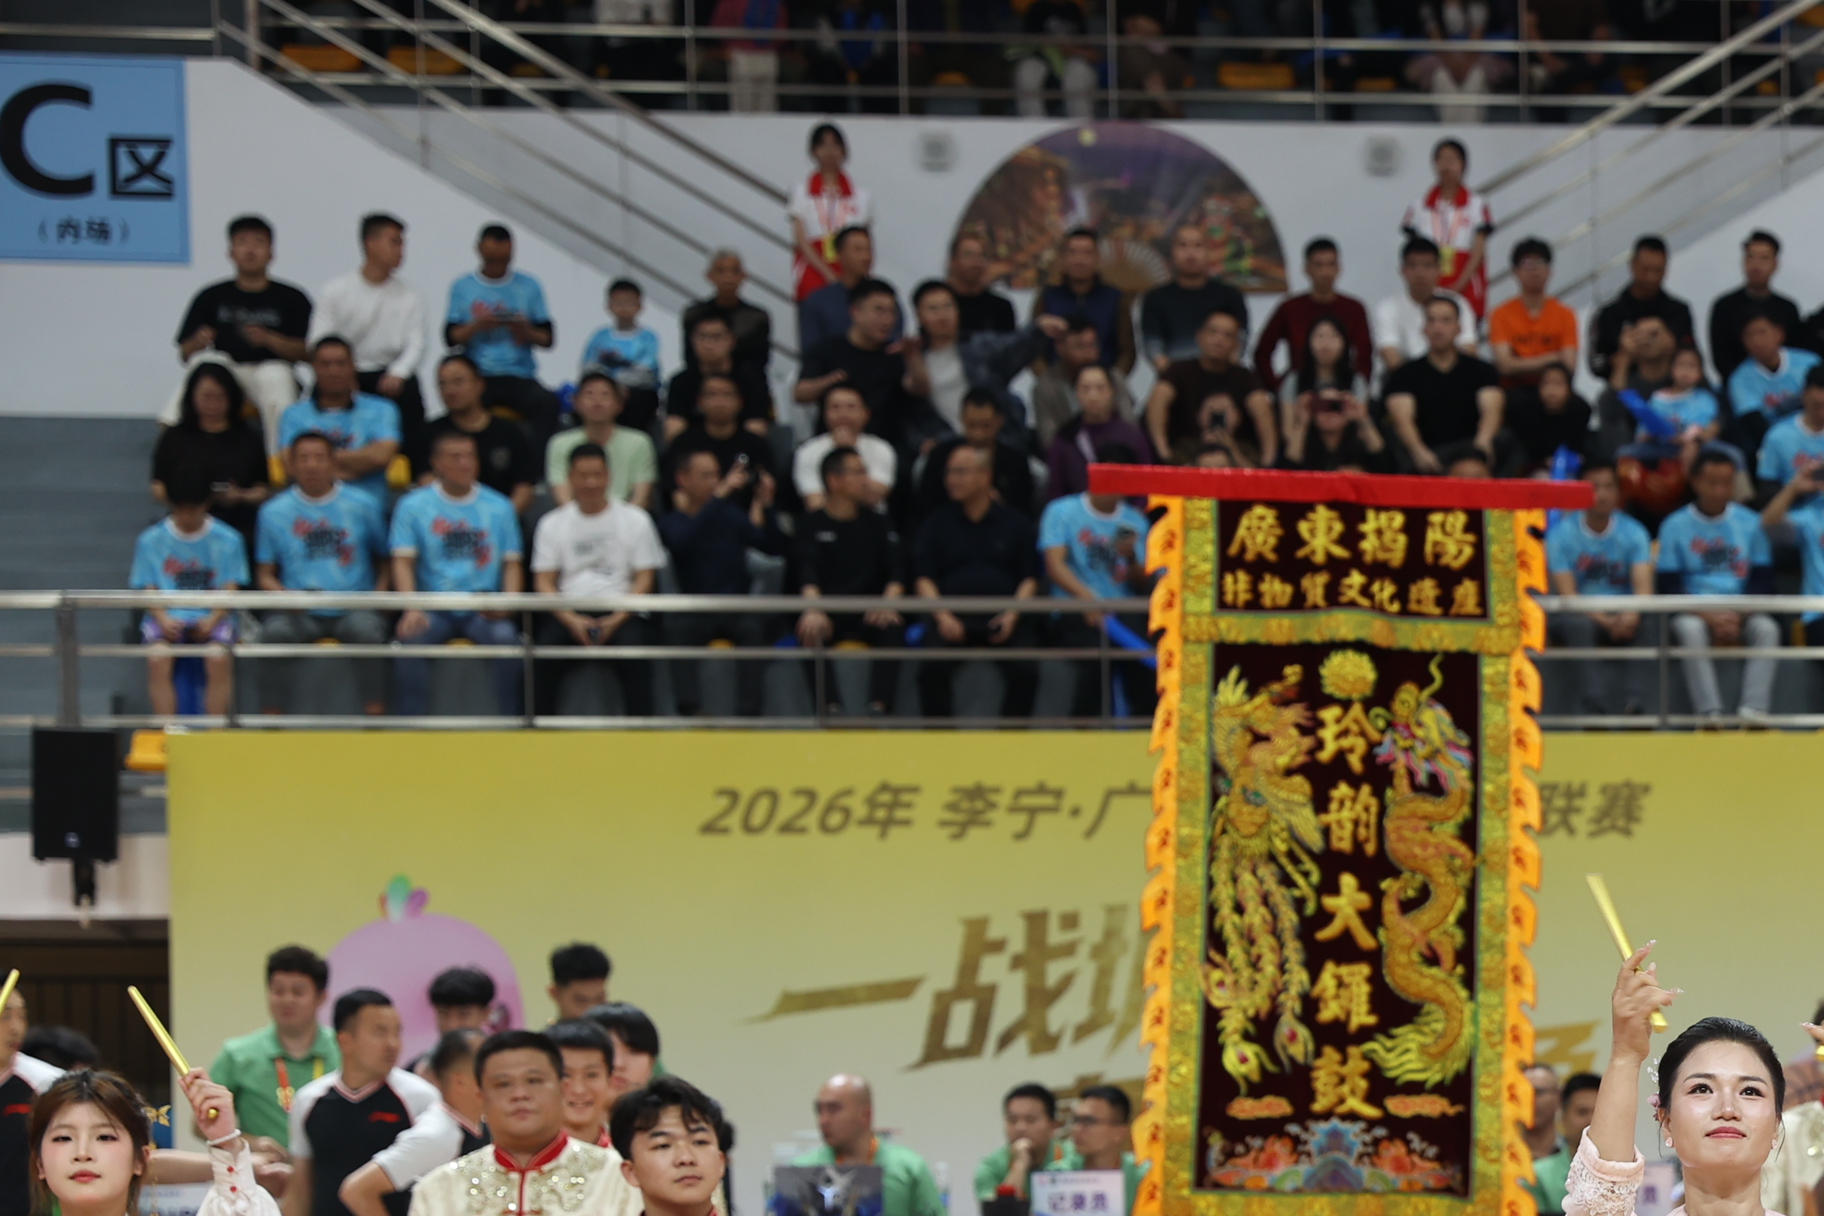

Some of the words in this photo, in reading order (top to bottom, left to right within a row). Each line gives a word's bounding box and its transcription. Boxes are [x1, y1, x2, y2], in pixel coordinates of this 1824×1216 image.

[1227, 503, 1478, 570] 廣東揭陽
[699, 782, 919, 840] 2026年
